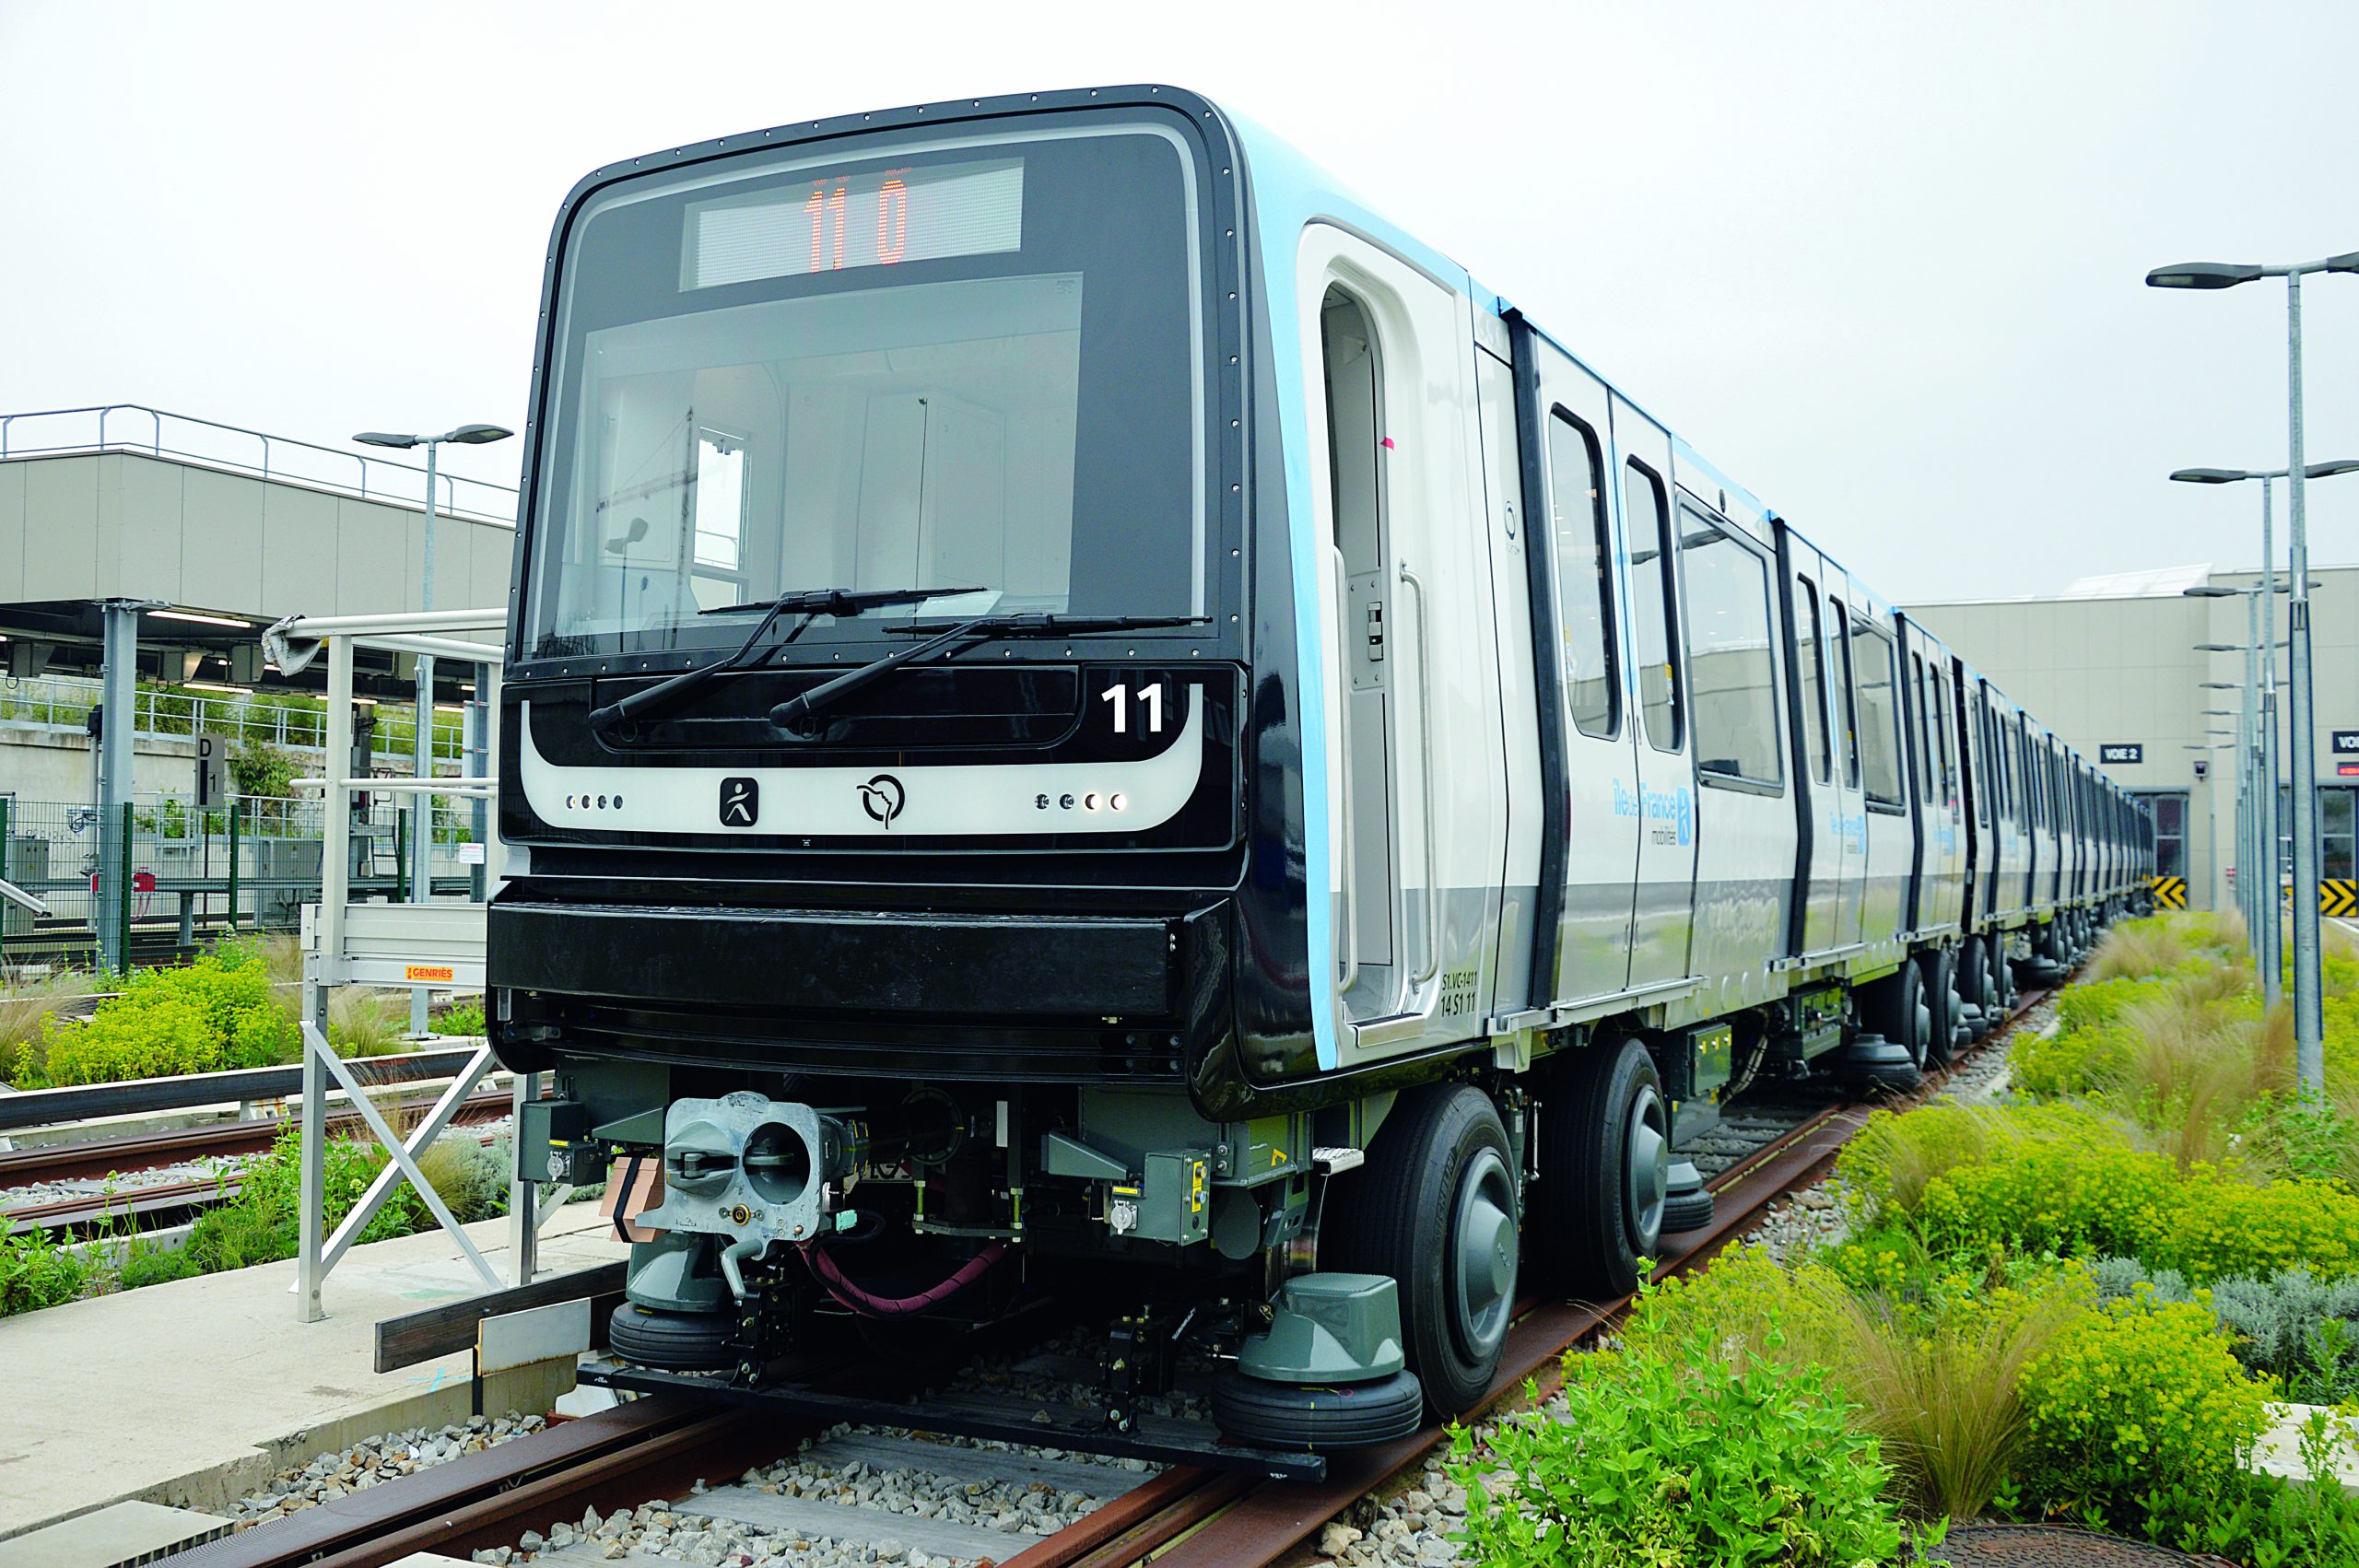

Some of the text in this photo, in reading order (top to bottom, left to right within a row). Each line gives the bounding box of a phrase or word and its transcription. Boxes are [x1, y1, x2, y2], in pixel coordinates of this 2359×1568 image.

[804, 187, 846, 274] 11
[1101, 683, 1162, 733] 11
[199, 738, 212, 757] D
[2104, 747, 2138, 760] VOIE 2
[209, 774, 216, 792] 1
[1442, 970, 1477, 990] S1.VC-1411
[1441, 991, 1475, 1017] 14 S1 11
